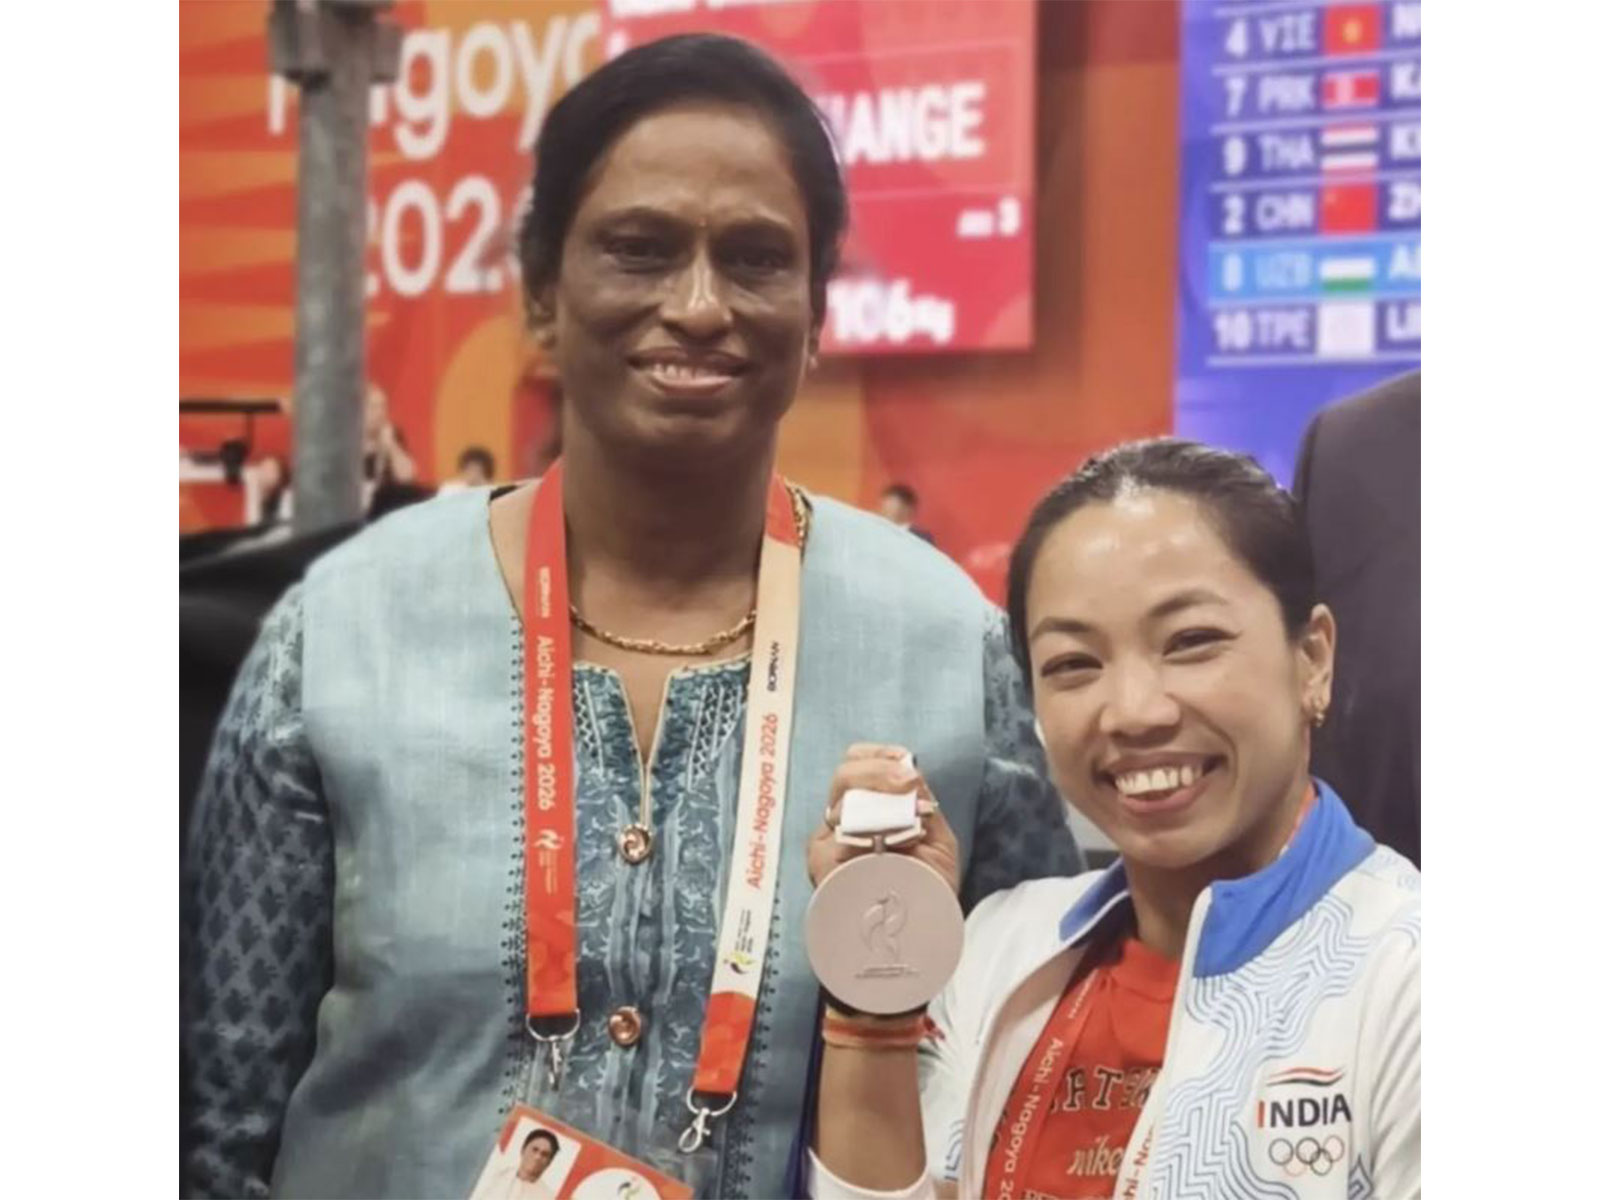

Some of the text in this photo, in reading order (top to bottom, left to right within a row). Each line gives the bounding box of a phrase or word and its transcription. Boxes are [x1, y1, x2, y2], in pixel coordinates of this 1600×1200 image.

[1259, 12, 1315, 51] VIE
[366, 175, 533, 297] 02
[759, 713, 779, 757] 2026
[537, 763, 556, 811] 2026
[1257, 1093, 1352, 1128] INDIA
